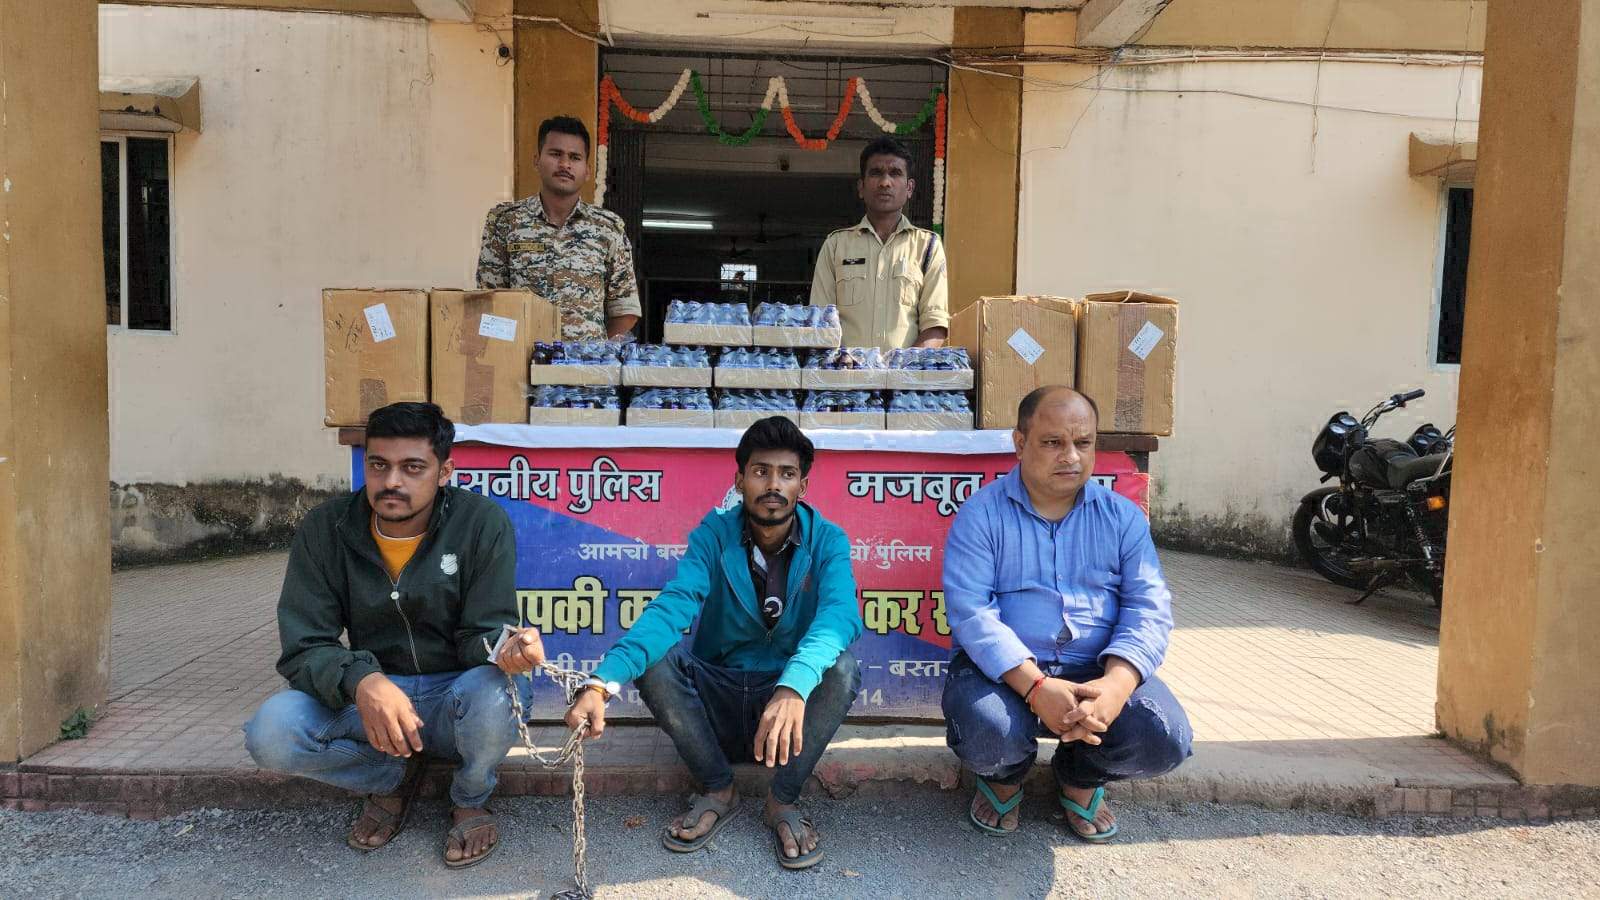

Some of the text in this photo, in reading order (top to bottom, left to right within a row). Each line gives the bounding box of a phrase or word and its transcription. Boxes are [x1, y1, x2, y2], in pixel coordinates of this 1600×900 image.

[567, 455, 663, 514] पुलिस
[847, 471, 985, 517] मजबूत
[577, 537, 650, 560] आमचो
[876, 539, 932, 569] पुलिस
[861, 589, 925, 636] कर
[888, 660, 951, 676] बस्त
[852, 689, 884, 705] 14
